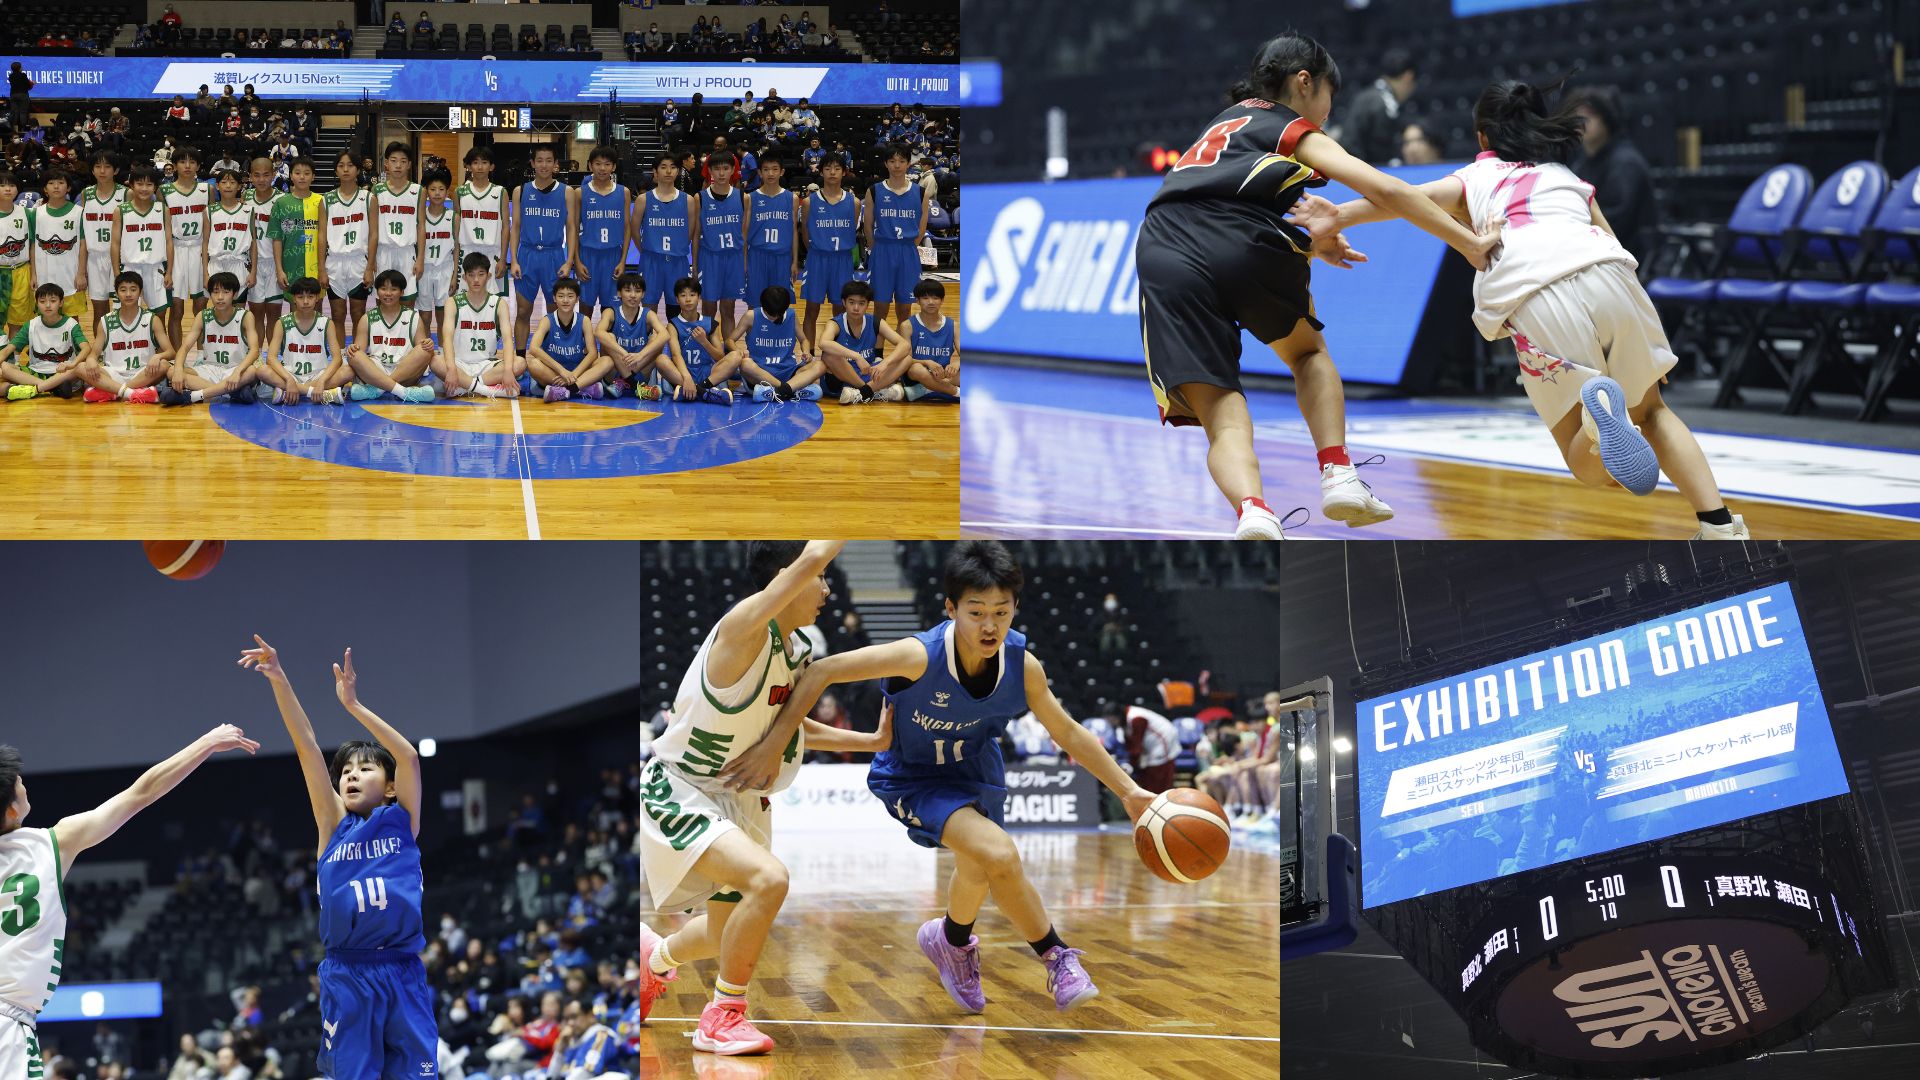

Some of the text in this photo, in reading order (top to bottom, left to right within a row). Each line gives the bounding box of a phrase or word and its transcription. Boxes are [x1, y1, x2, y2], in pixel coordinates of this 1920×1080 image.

[36, 70, 62, 83] LAKES
[213, 72, 340, 84] 滋賀レイクスU15Next
[656, 77, 751, 88] WITH J PROUD
[886, 78, 909, 91] WITH
[921, 79, 949, 91] PROUD
[462, 109, 477, 128] 41
[501, 110, 517, 128] 39
[96, 228, 110, 242] 15
[182, 222, 199, 236] 22
[389, 222, 403, 235] 18
[538, 227, 543, 240] 1
[601, 228, 608, 242] 8
[344, 231, 356, 245] 19
[663, 236, 671, 250] 6
[719, 233, 734, 248] 13
[765, 229, 779, 243] 10
[138, 237, 152, 251] 12
[223, 237, 236, 250] 13
[831, 237, 839, 251] 7
[429, 245, 440, 258] 11
[470, 338, 486, 351] 23
[124, 356, 140, 370] 14
[214, 351, 229, 364] 16
[686, 350, 700, 364] 12
[295, 362, 312, 375] 20
[1374, 596, 1783, 752] EXHIBITION GAME
[934, 740, 964, 764] 11
[1613, 722, 1794, 778] 真野北ミニバスケットボール部
[1414, 751, 1524, 787] 瀬田スポーツ少年団
[1406, 760, 1536, 800] ミニバスケットボール部
[1585, 874, 1626, 902] 5:00
[1660, 866, 1685, 907] 0
[1714, 876, 1770, 897] 真野北
[350, 876, 388, 913] 14
[1, 872, 41, 936] 3
[1539, 896, 1558, 941] 0
